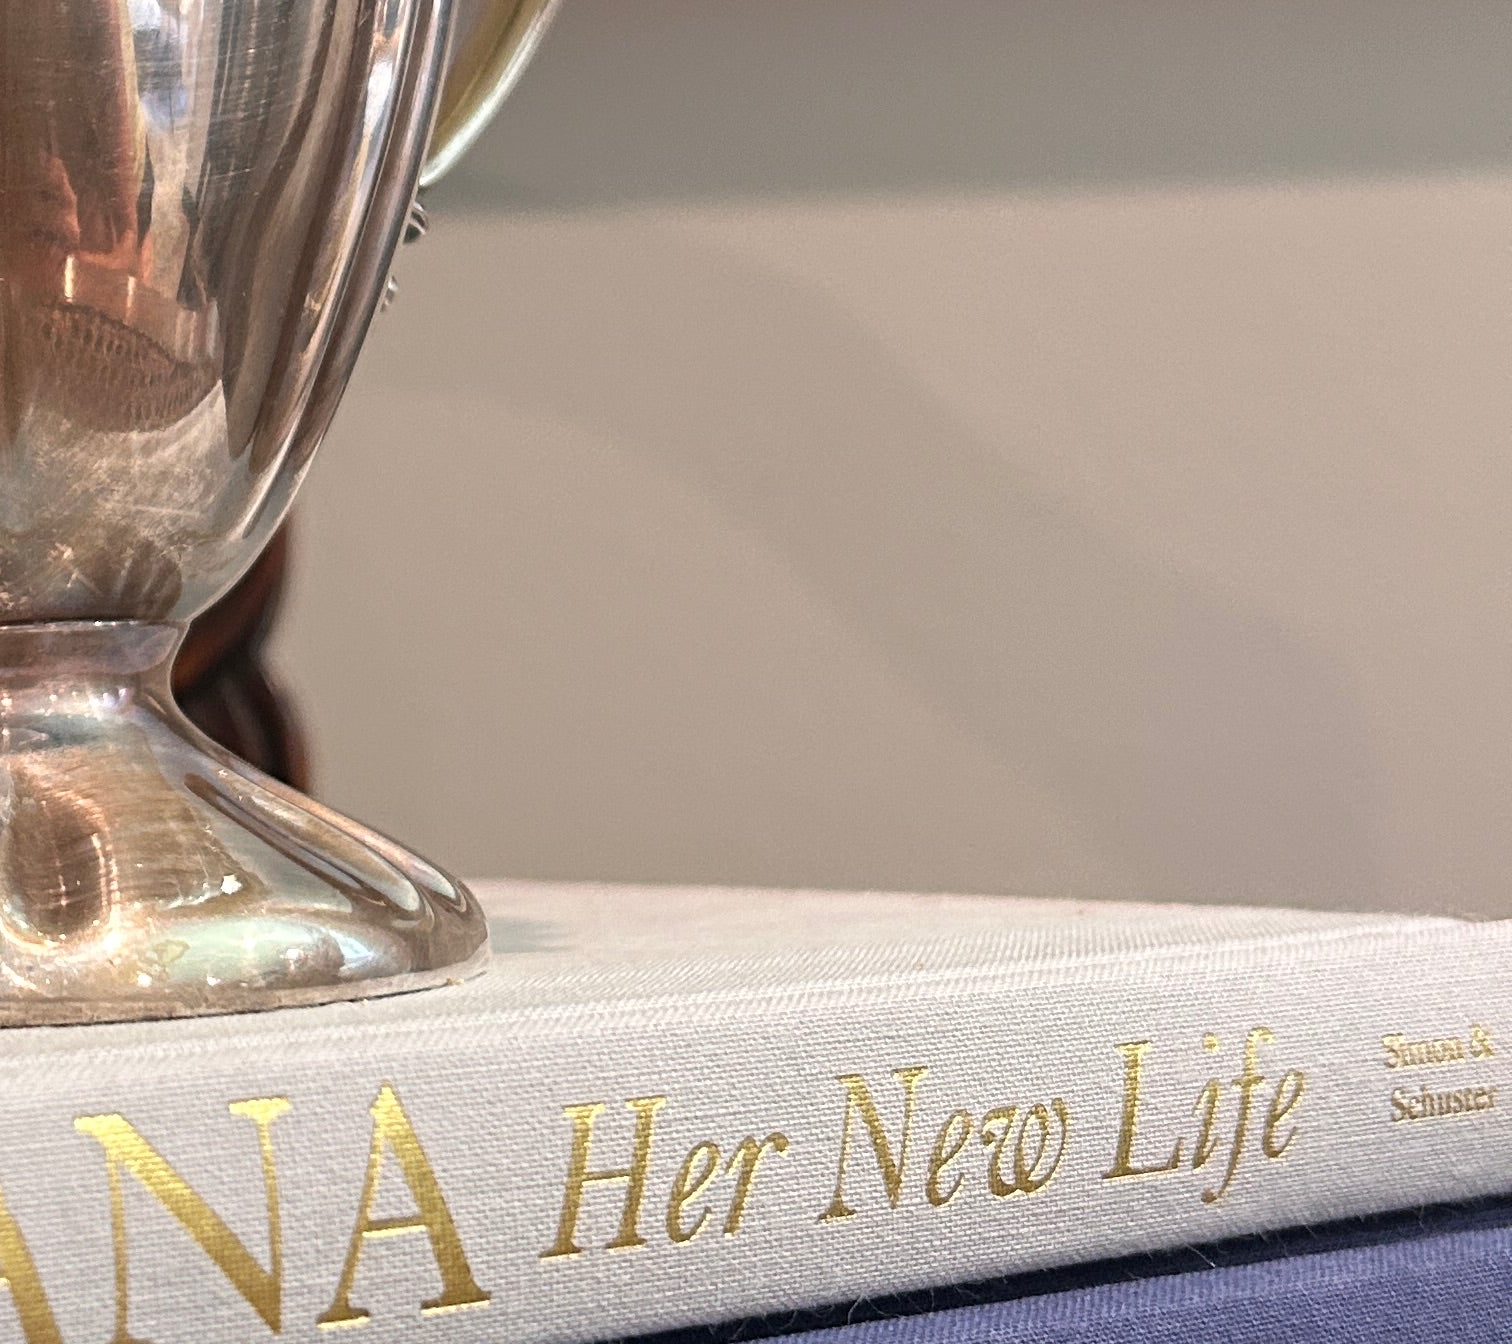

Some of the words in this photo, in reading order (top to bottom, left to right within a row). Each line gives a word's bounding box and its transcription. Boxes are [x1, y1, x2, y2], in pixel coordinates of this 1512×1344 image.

[1382, 1031, 1464, 1070] Simon
[1467, 1023, 1495, 1060] &
[1389, 1084, 1498, 1123] Schuster
[540, 1094, 788, 1259] Her
[817, 1065, 1072, 1226] New
[1101, 1026, 1306, 1204] Life
